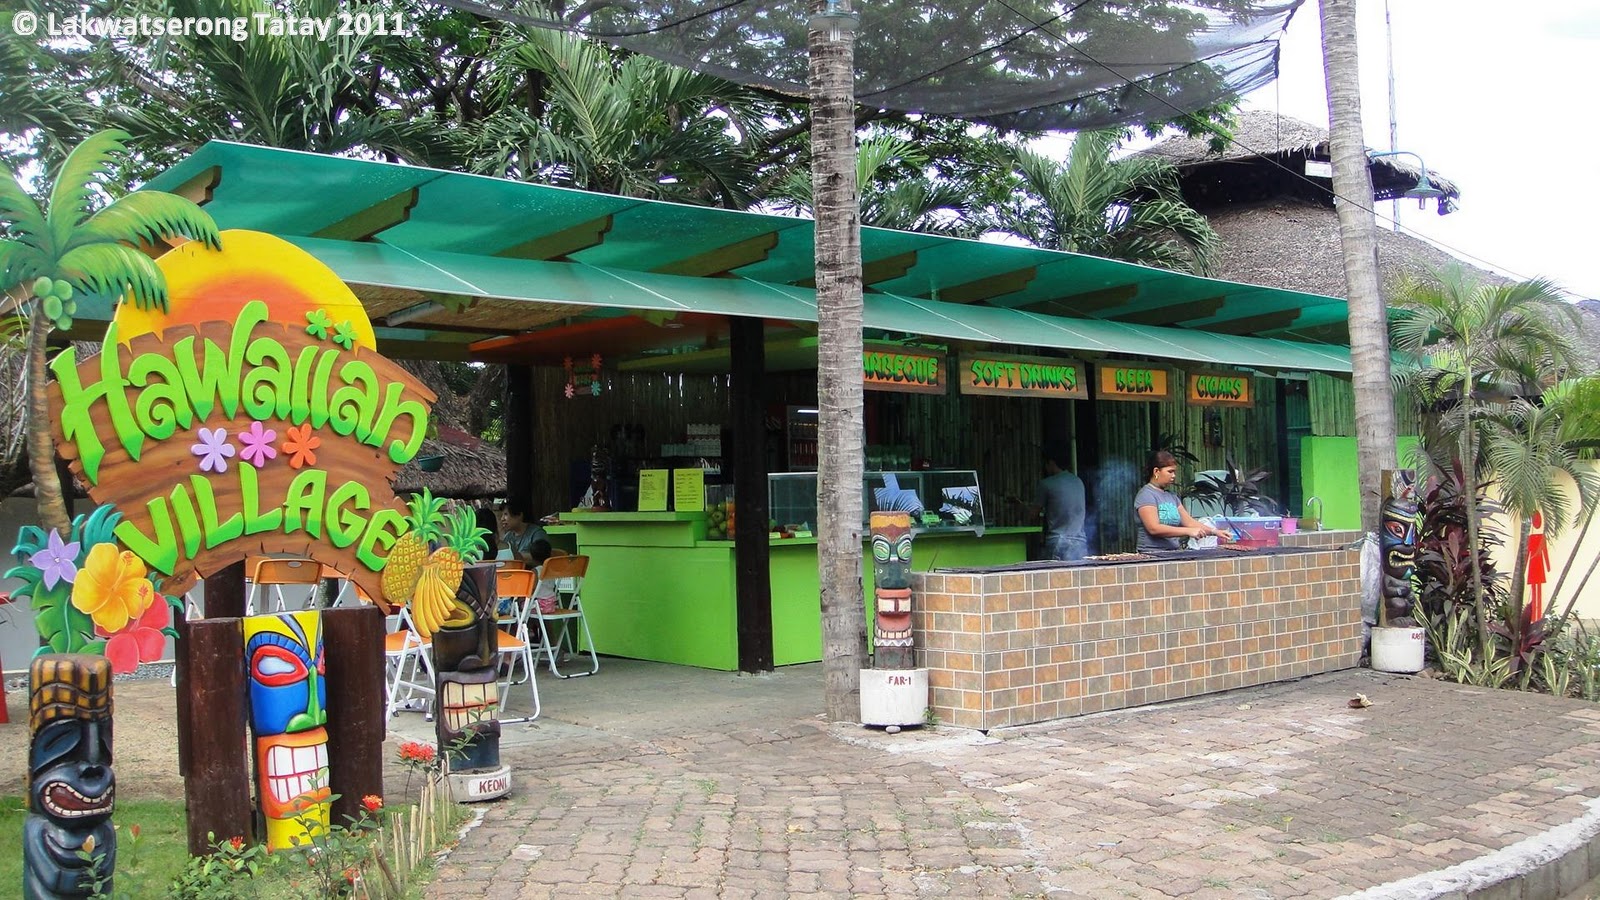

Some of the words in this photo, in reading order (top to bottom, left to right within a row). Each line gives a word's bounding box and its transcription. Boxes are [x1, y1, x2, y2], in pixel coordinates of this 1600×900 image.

[863, 352, 938, 384] ARBEQUE
[970, 360, 1015, 386] SOFT
[1020, 363, 1077, 391] DRINKS
[1116, 369, 1154, 393] BEER
[50, 300, 429, 487] Hawaiian
[1197, 375, 1243, 400] CIGARS
[114, 462, 410, 576] VILLAGE
[479, 777, 507, 794] KEONI
